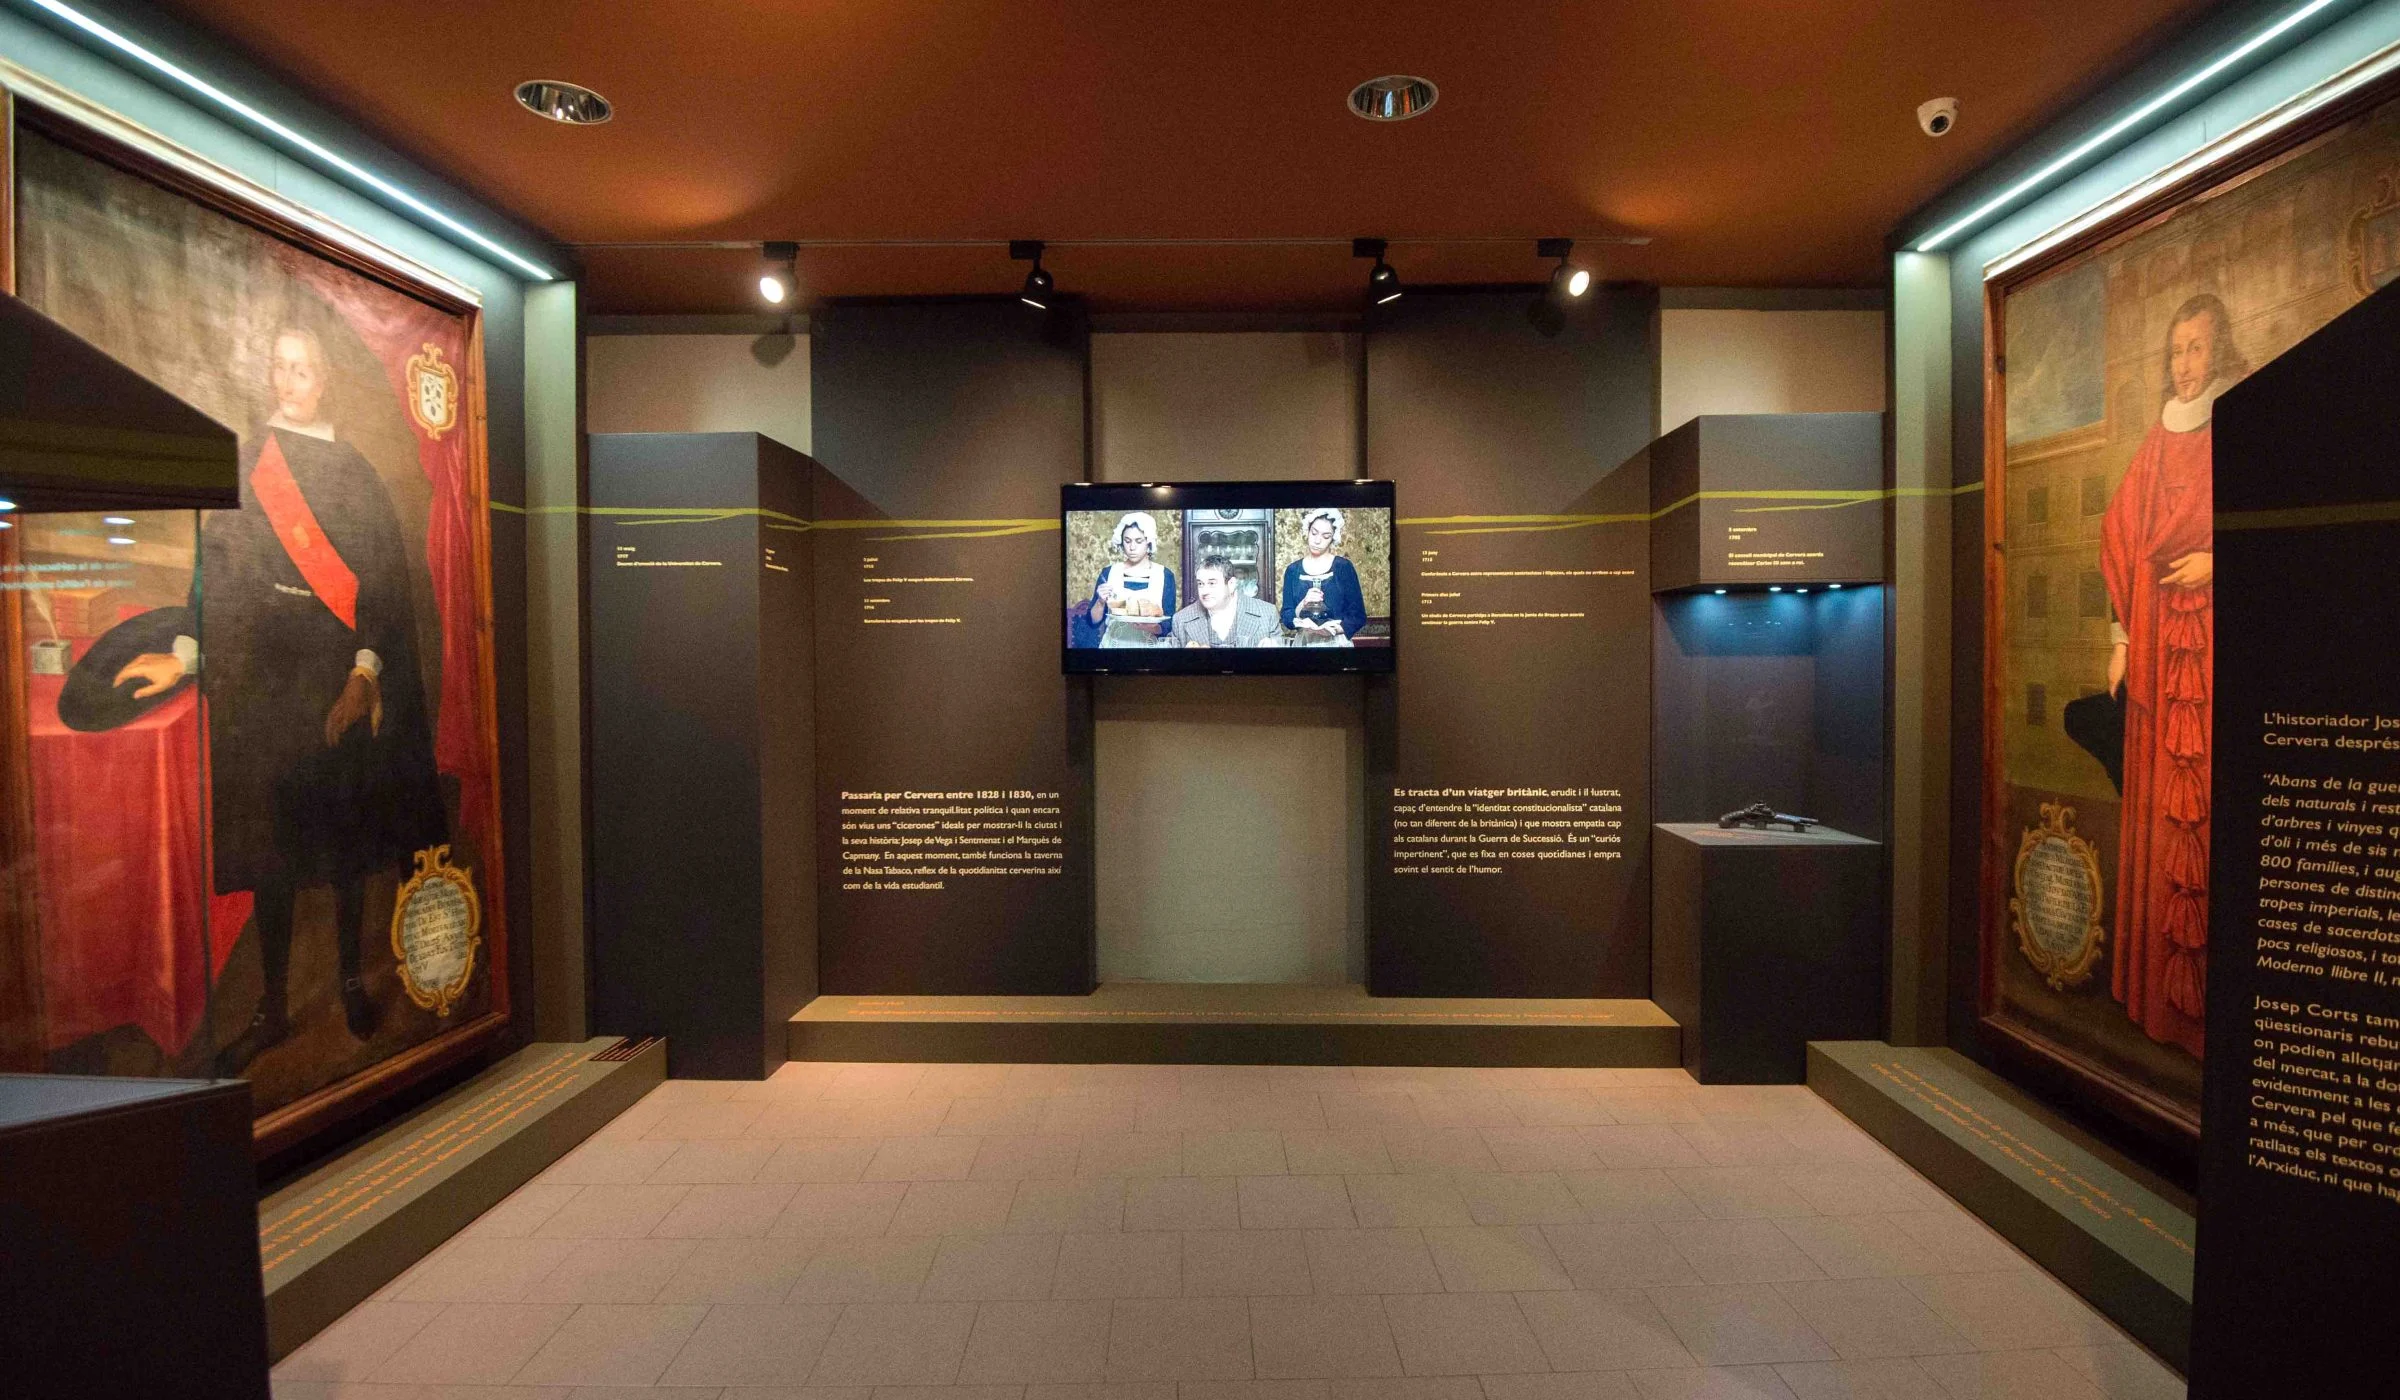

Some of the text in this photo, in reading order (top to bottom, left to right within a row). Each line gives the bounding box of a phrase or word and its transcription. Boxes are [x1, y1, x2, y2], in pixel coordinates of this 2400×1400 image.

[2374, 716, 2400, 730] Jos
[2264, 733, 2400, 752] Cervera després
[1394, 788, 1405, 796] Es
[1468, 787, 1505, 799] viatger
[1550, 788, 1576, 796] erudit
[2323, 777, 2342, 789] de
[2348, 778, 2362, 790] la
[2368, 783, 2400, 794] gue
[842, 791, 882, 799] Passaria
[884, 793, 902, 801] per
[903, 791, 944, 799] Cervera
[946, 791, 974, 799] entre
[977, 790, 999, 799] 1828
[890, 806, 921, 814] relativa
[1010, 808, 1030, 816] quan
[1464, 803, 1471, 812] la
[1589, 803, 1622, 812] catalana
[2262, 794, 2400, 814] dels naturals rest
[941, 821, 965, 829] ideals
[966, 823, 981, 831] per
[983, 821, 1023, 829] mostrar-li
[1394, 819, 1408, 829] (no
[1425, 819, 1456, 827] diferent
[1458, 819, 1469, 827] de
[1471, 819, 1478, 827] la
[1524, 821, 1540, 829] que
[1542, 820, 1571, 828] mostra
[1573, 819, 1605, 829] empatia
[1607, 821, 1622, 829] cap
[2338, 821, 2382, 836] vinyes
[901, 836, 923, 847] Josep
[934, 836, 953, 846] Vega
[959, 836, 1001, 844] Sentmenat
[1394, 834, 1404, 842] als
[1440, 834, 1467, 843] durant
[1469, 834, 1476, 842] la
[1478, 834, 1508, 843] Guerra
[1510, 834, 1521, 843] de
[884, 851, 895, 860] En
[896, 853, 923, 861] aquest
[989, 851, 1022, 859] funciona
[1451, 852, 1467, 860] que
[1481, 849, 1496, 858] fixa
[1537, 849, 1586, 860] quotidianes
[1593, 851, 1621, 860] empra
[2306, 840, 2337, 852] més
[2343, 842, 2362, 854] de
[2368, 844, 2387, 856] sis
[1421, 865, 1429, 873] el
[1431, 865, 1454, 873] sentit
[1456, 865, 1467, 873] de
[2260, 855, 2291, 868] 800
[863, 866, 883, 874] Nasa
[914, 866, 936, 874] reflex
[958, 866, 1007, 876] quotidianitat
[1009, 866, 1045, 874] cerverina
[883, 881, 900, 890] vida
[2260, 877, 2325, 892] persones
[2331, 882, 2349, 895] de
[2260, 898, 2304, 912] tropes
[2310, 902, 2383, 921] imperials,
[2258, 919, 2400, 943] cases de sacerdots
[2258, 938, 2366, 962] pocs religiosos,
[2257, 956, 2386, 986] Moderno llibre II,
[2254, 996, 2399, 1028] Josep Corts tam
[2255, 1018, 2400, 1049] qüestionaris rebu
[2254, 1039, 2273, 1049] on
[2280, 1043, 2335, 1060] podien
[2254, 1056, 2369, 1087] del mercat, la
[2252, 1076, 2390, 1112] evidentment les
[2252, 1096, 2315, 1118] Cervera
[2322, 1112, 2345, 1124] pel
[2352, 1118, 2382, 1131] que
[2264, 1121, 2366, 1148] més, que per
[2250, 1138, 2383, 1174] ratllats els textos
[2324, 1174, 2337, 1184] ni
[2343, 1179, 2372, 1192] que
